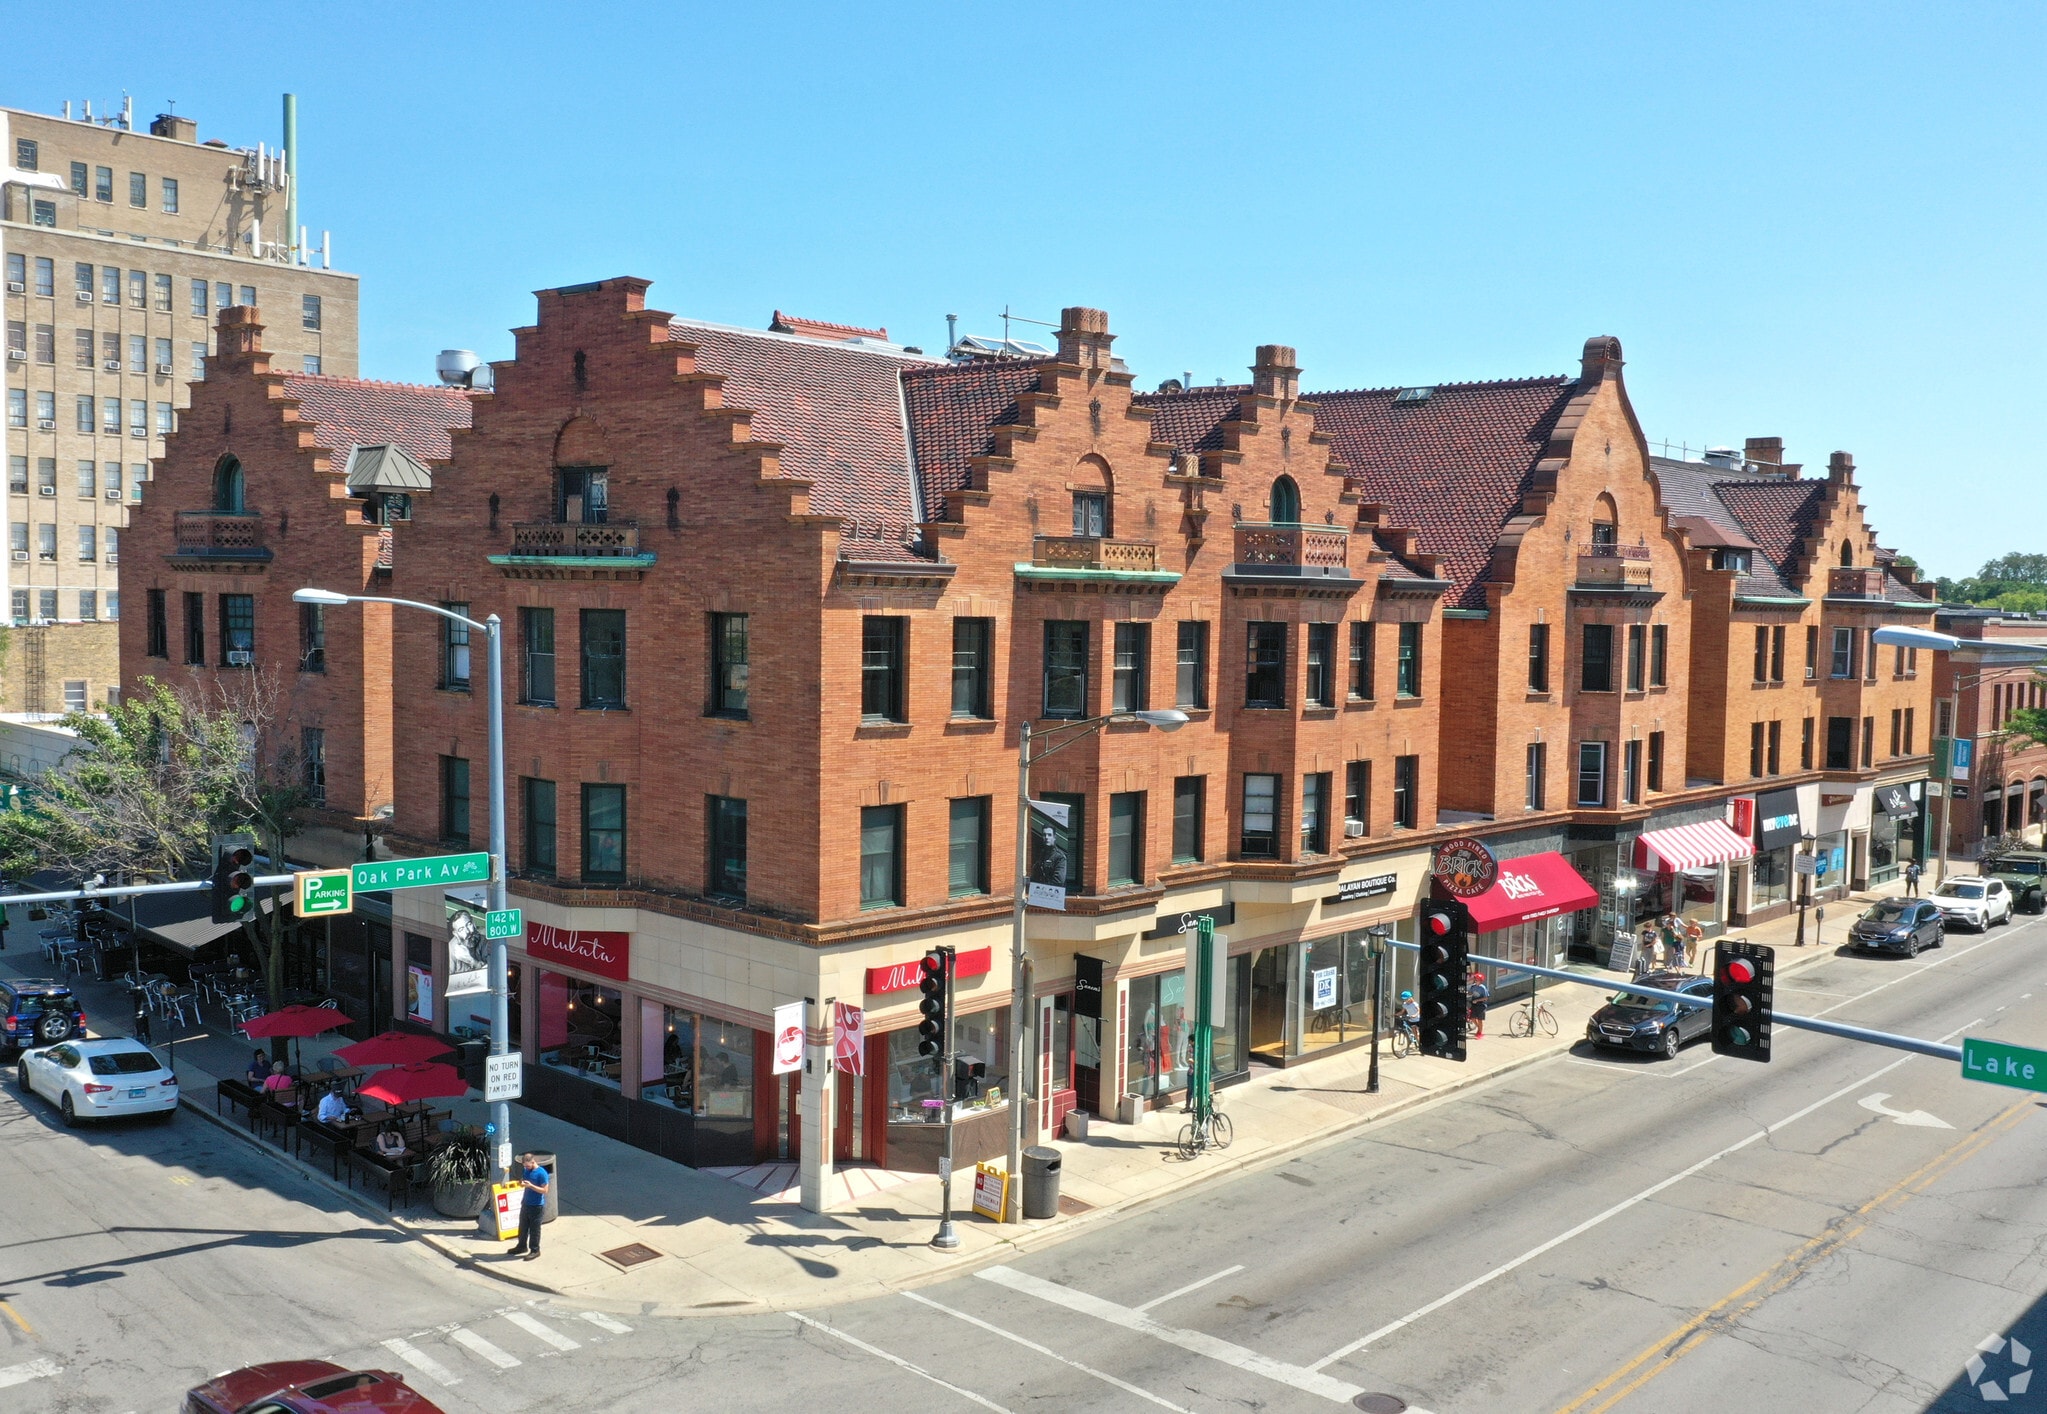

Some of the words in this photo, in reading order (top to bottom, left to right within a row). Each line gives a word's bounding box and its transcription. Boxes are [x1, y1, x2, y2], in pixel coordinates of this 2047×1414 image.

[1443, 841, 1464, 853] WOOD
[1467, 842, 1488, 859] FIRED
[358, 870, 388, 885] Oak
[396, 866, 432, 881] Park
[441, 863, 460, 877] Av
[1435, 855, 1493, 879] BRICKS
[305, 878, 346, 900] PARKING
[1361, 876, 1388, 889] BOUTIQUE
[1443, 879, 1463, 895] PIZZA
[491, 913, 507, 924] 142
[509, 912, 515, 922] N
[490, 925, 508, 937] 800
[510, 924, 517, 934] W
[531, 924, 616, 963] Mulata
[489, 1063, 499, 1072] NO
[501, 1061, 519, 1070] TURN
[1967, 1048, 2036, 1080] Lake
[490, 1075, 500, 1083] ON
[503, 1072, 517, 1081] RED
[492, 1085, 500, 1093] AM
[500, 1084, 507, 1092] TO
